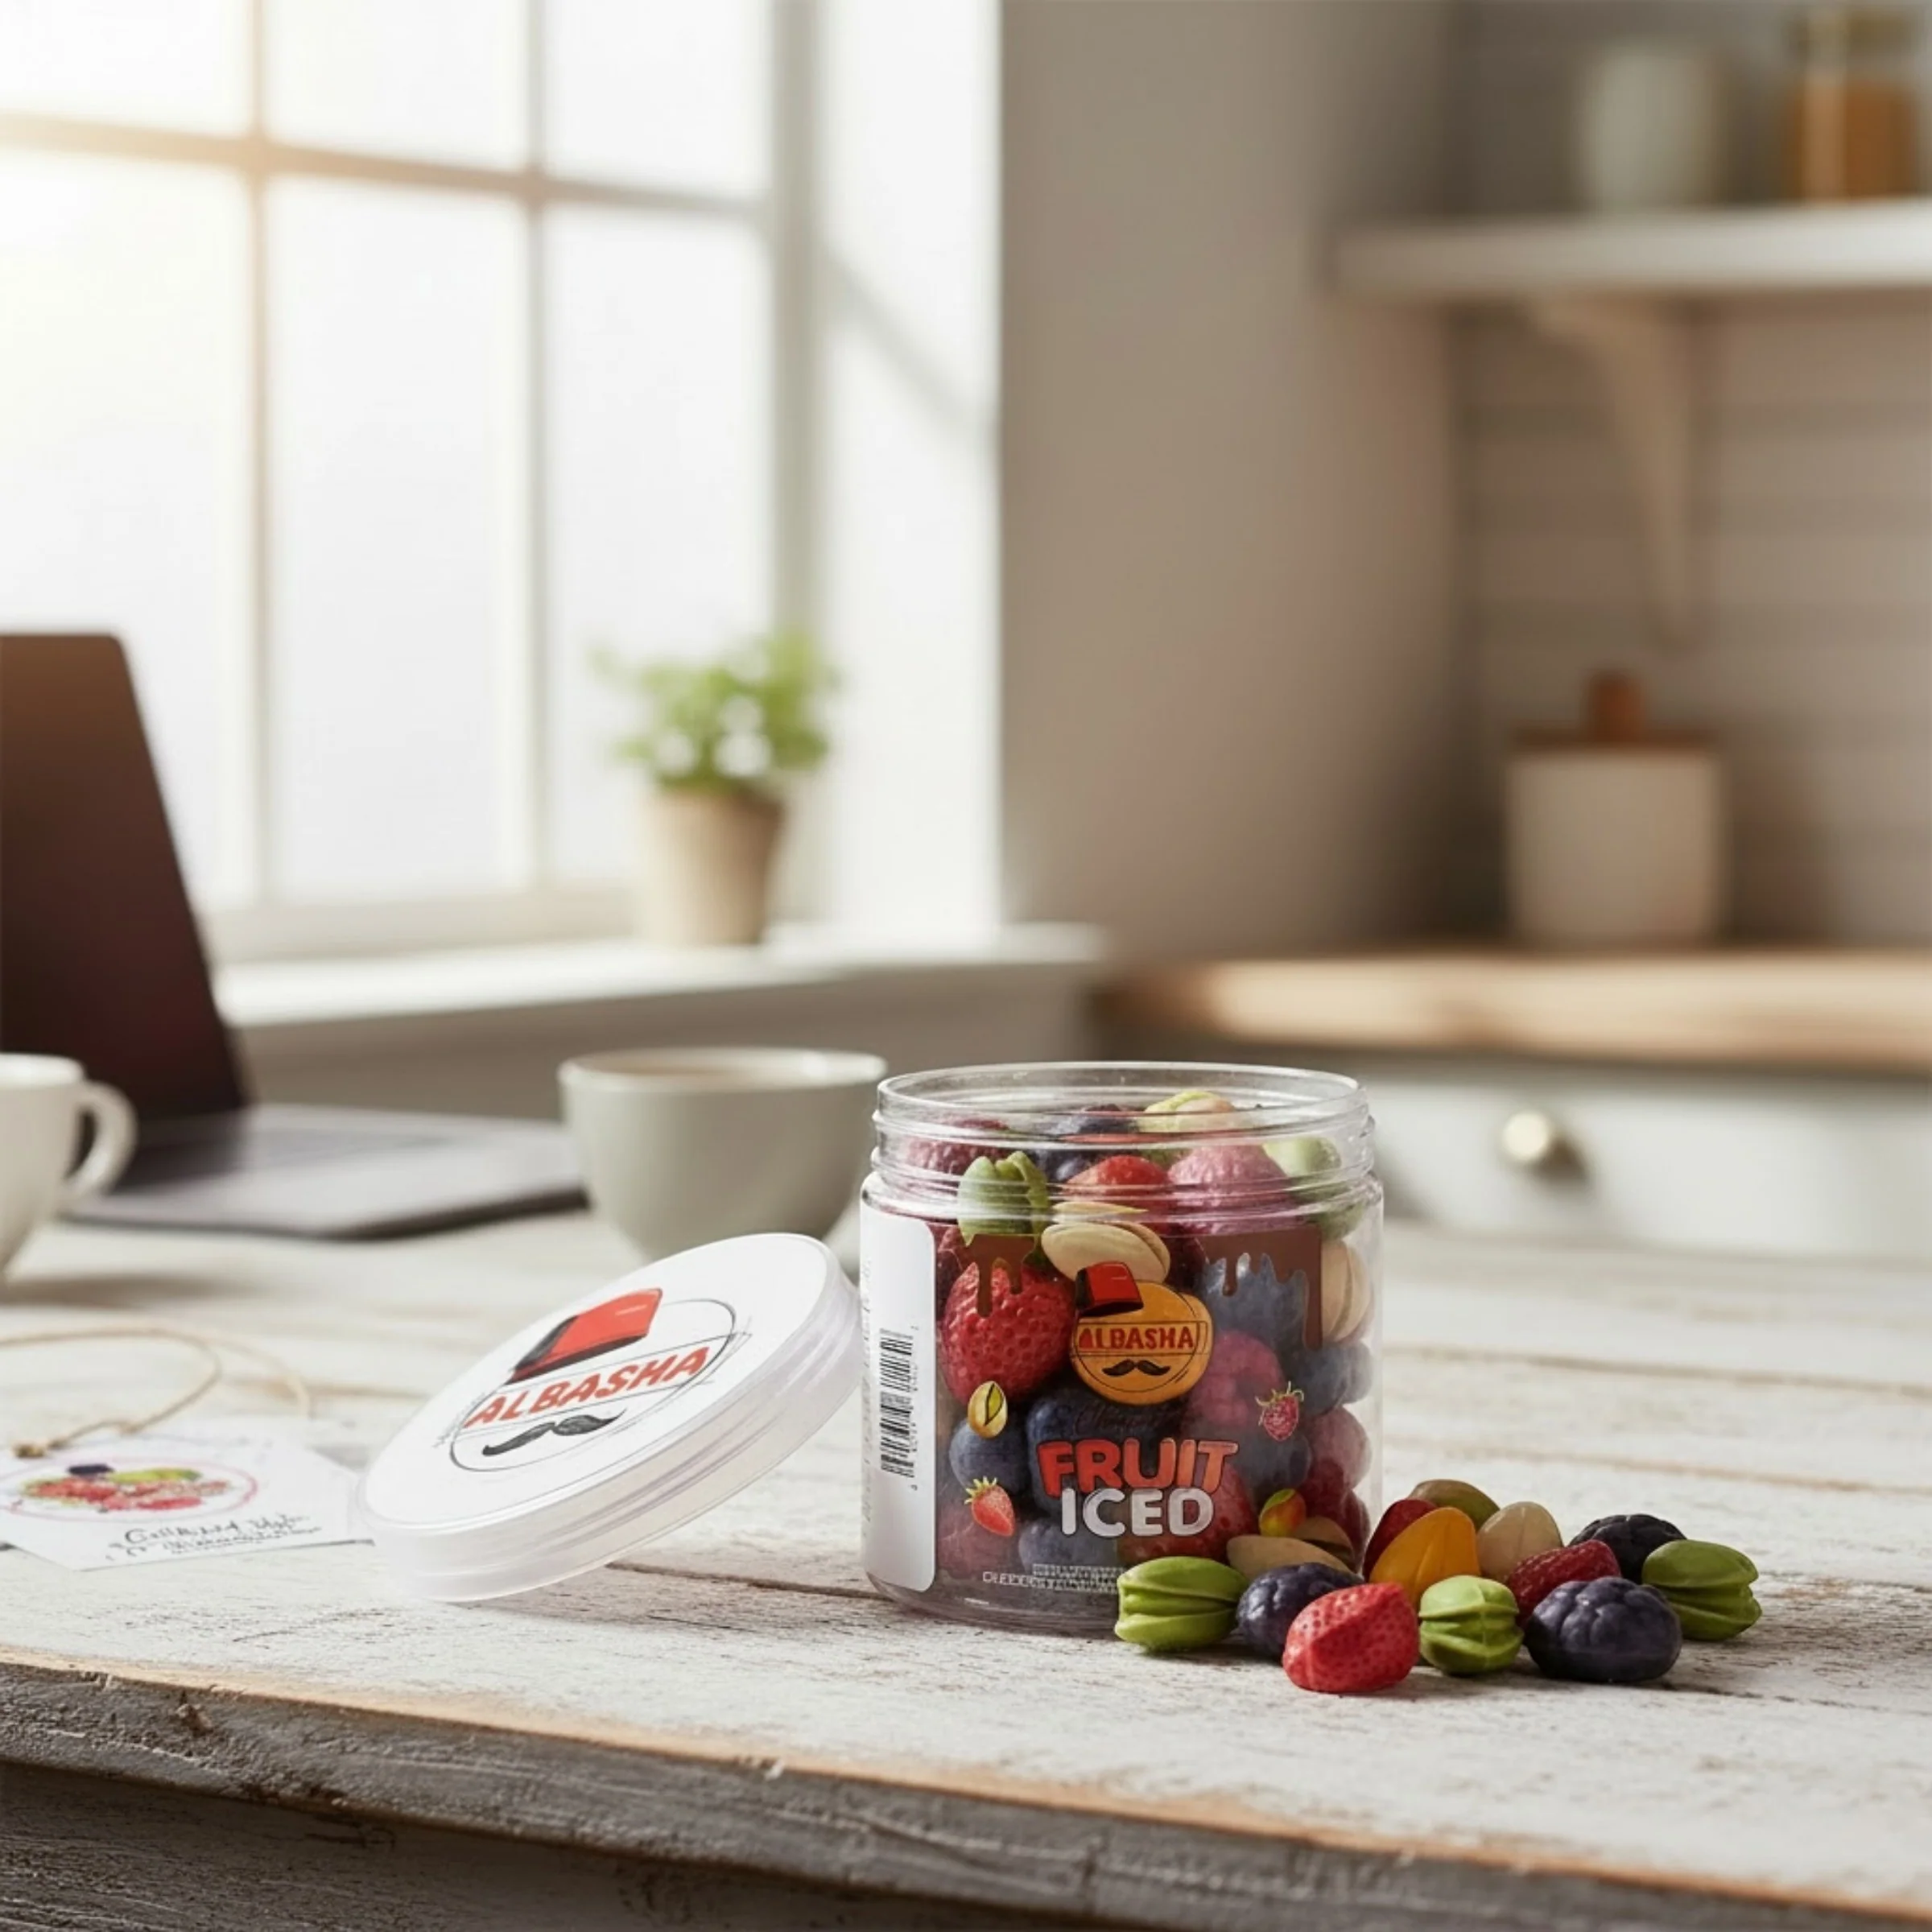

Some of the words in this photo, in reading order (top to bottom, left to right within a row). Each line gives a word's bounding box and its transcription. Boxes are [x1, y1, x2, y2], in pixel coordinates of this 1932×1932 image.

[1079, 1326, 1194, 1349] ALBASHA
[462, 1346, 711, 1429] ALBASHA
[1037, 1437, 1239, 1498] FRUIT
[1061, 1487, 1215, 1538] ICED
